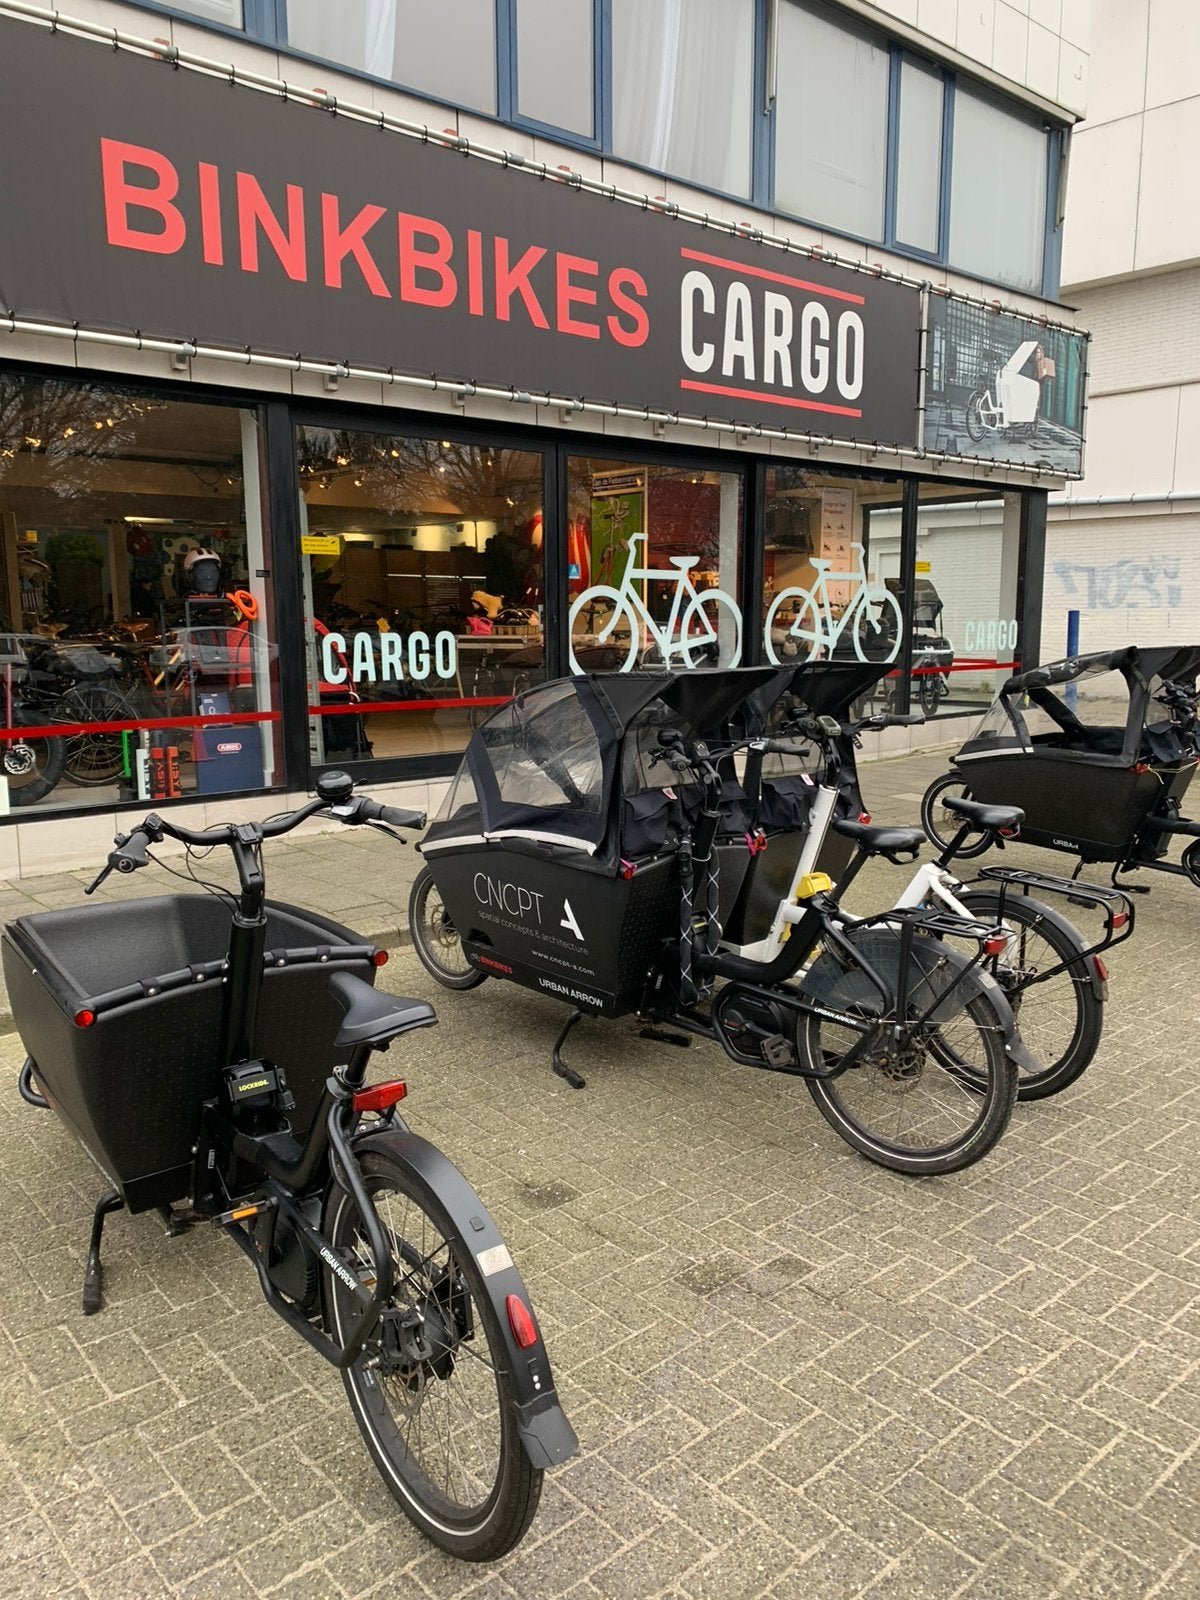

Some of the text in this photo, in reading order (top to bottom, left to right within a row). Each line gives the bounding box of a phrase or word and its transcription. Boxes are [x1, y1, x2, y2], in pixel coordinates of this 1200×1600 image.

[100, 137, 865, 401] BINKBIKES CARGO
[322, 630, 457, 685] CARGO
[965, 619, 1018, 652] CARGO
[473, 872, 544, 924] CNCPT
[478, 910, 501, 924] spatial
[501, 919, 534, 938] concepts
[541, 933, 589, 956] architecture
[531, 949, 596, 976] www.cncpt-a.com
[538, 977, 603, 1008] URBAN ARROW
[814, 1007, 857, 1025] URBAN ARROW
[320, 1246, 358, 1291] URBAN ARROW
